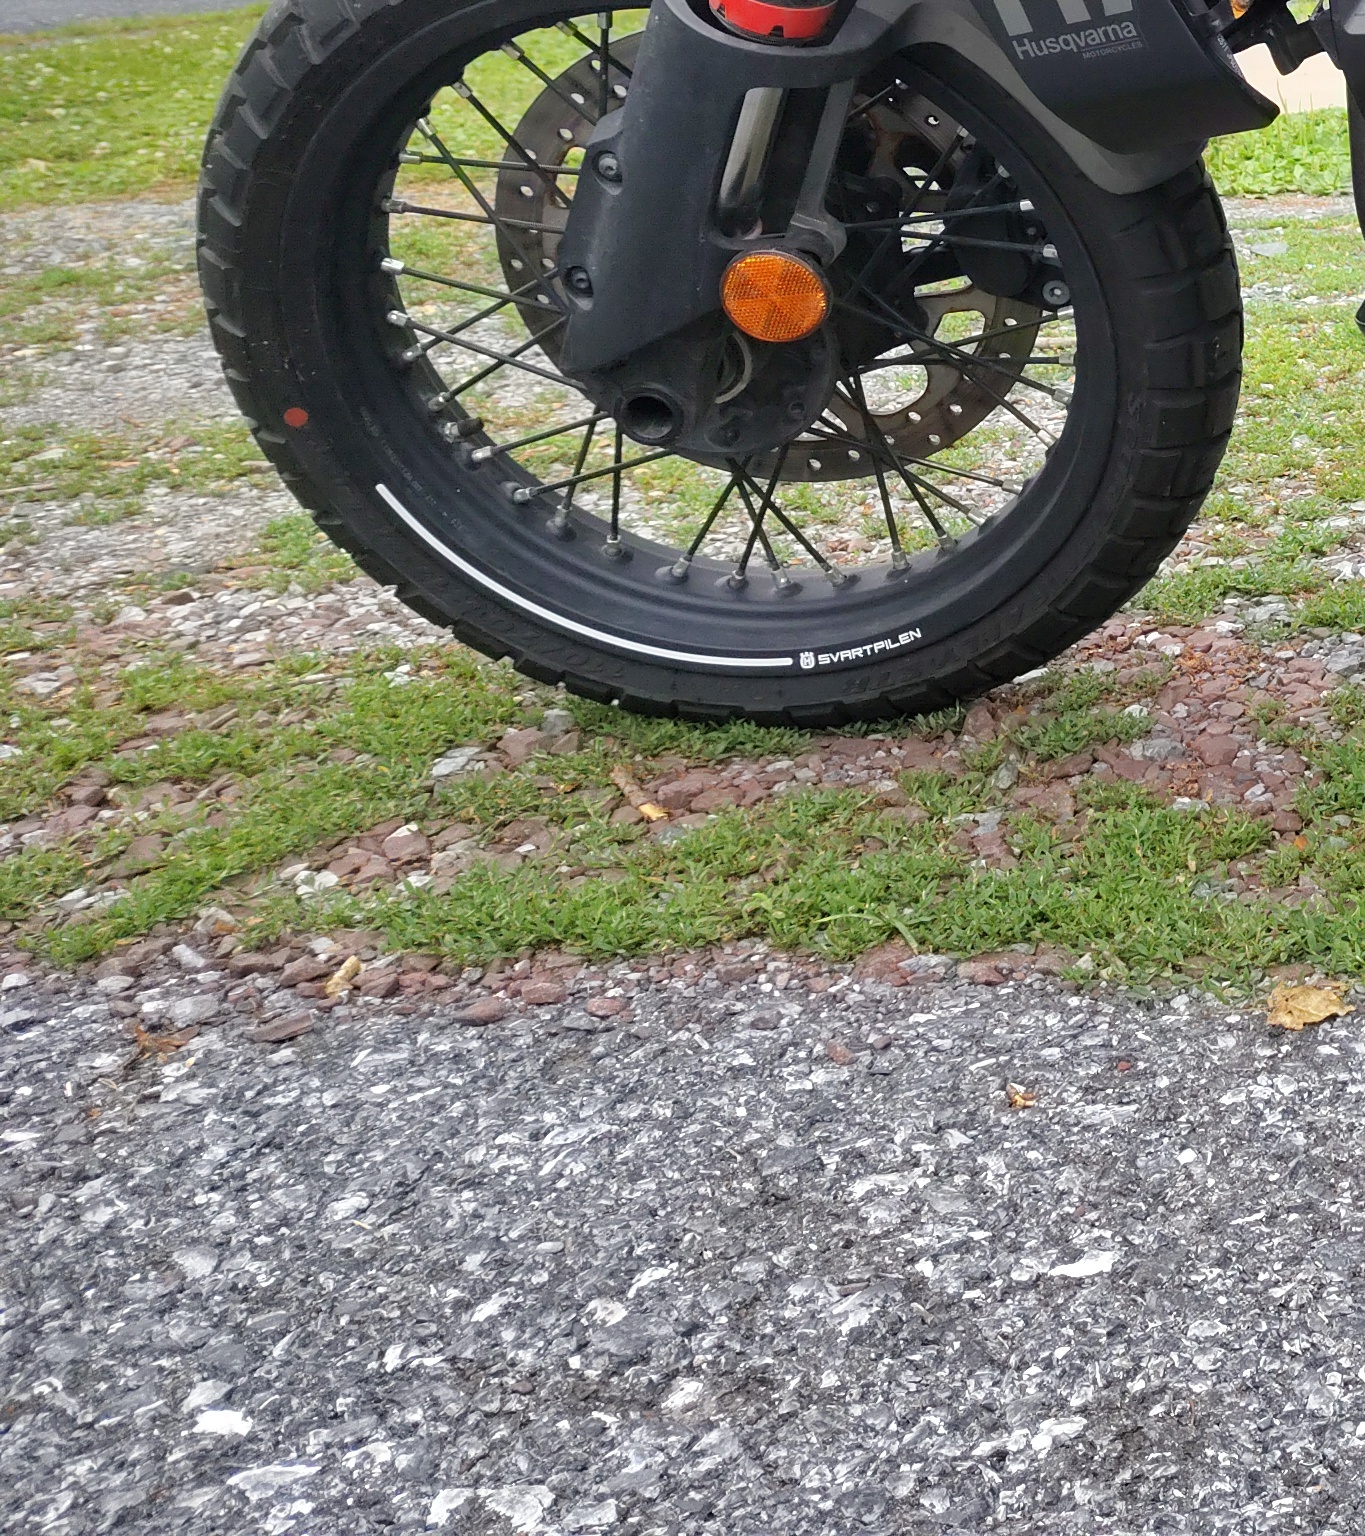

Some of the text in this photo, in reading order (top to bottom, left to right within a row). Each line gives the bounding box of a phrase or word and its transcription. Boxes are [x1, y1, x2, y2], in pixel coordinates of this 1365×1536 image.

[1012, 21, 1138, 60] Husqvarna
[1082, 41, 1143, 59] MOTORCYCLES
[817, 627, 922, 665] SVARTPILEN
